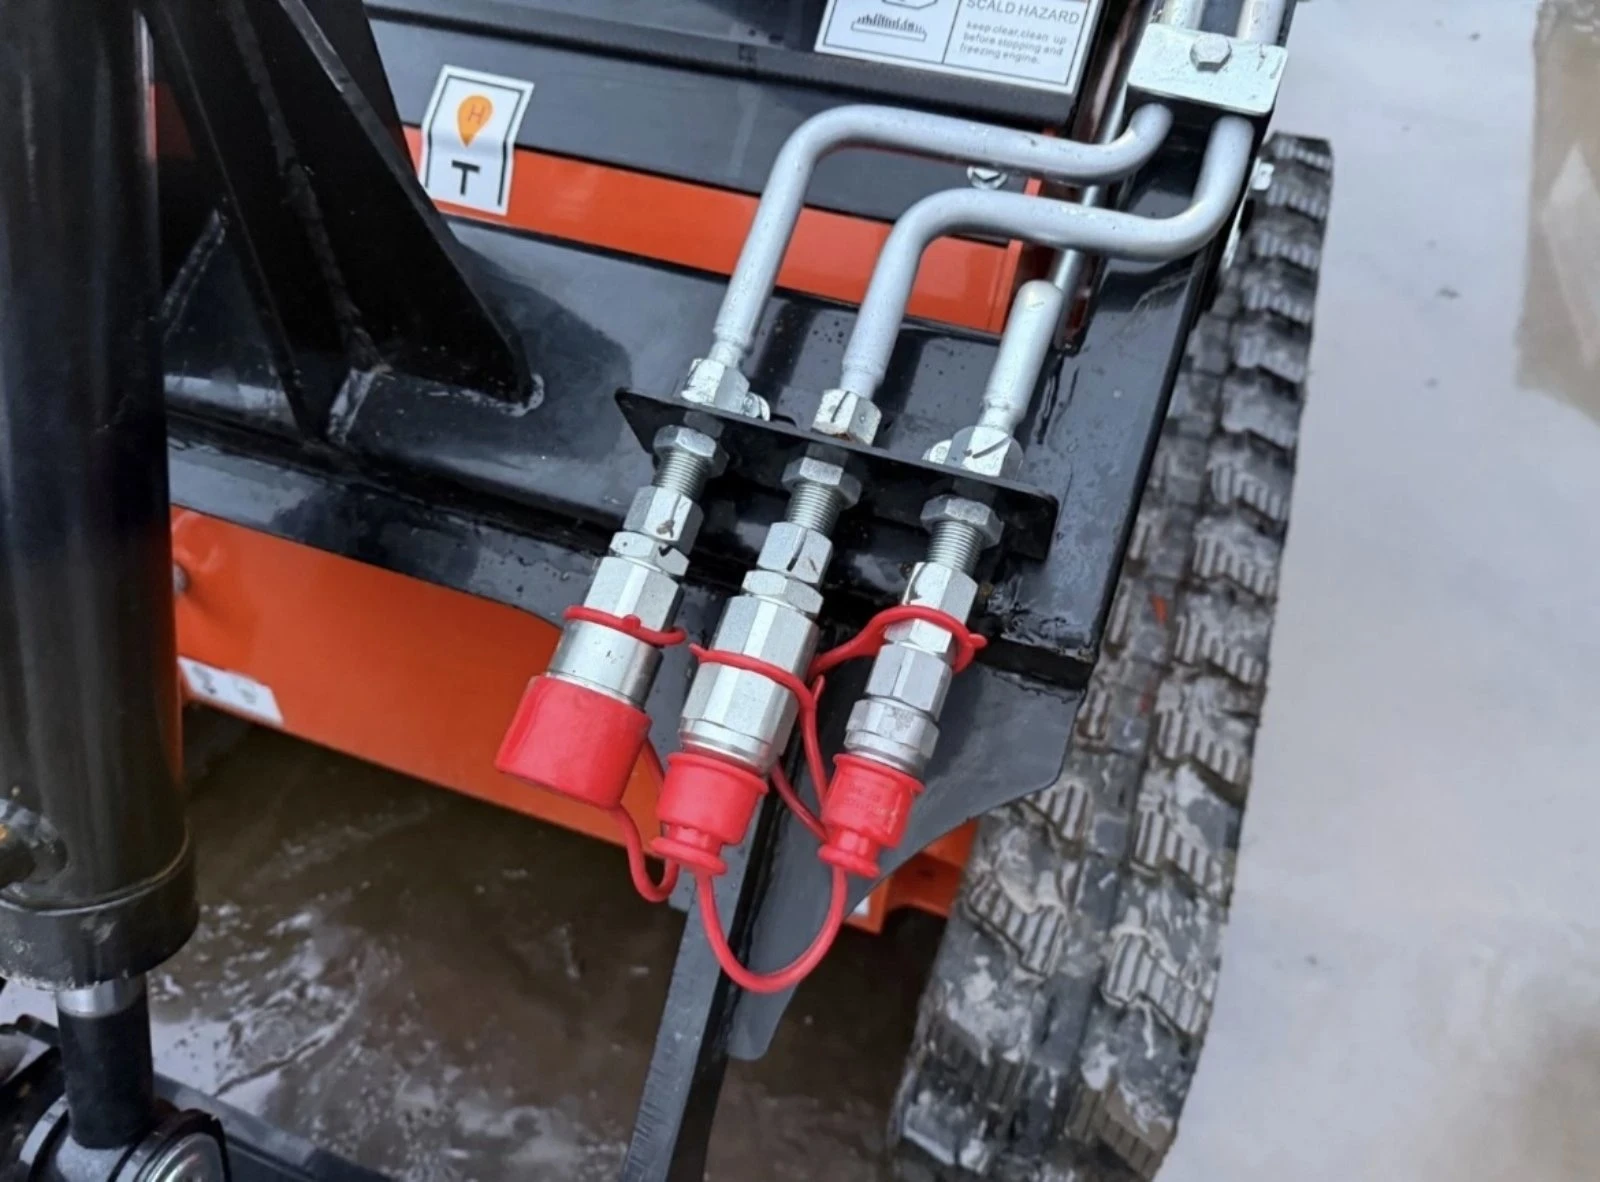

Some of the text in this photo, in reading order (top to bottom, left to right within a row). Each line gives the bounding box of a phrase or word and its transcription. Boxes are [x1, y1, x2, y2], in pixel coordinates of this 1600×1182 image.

[966, 0, 1080, 24] SCALD HAZARD
[966, 20, 991, 33] keep
[959, 42, 1001, 60] freezing
[963, 31, 1064, 56] before stopping and
[467, 103, 485, 125] H
[451, 159, 481, 196] T
